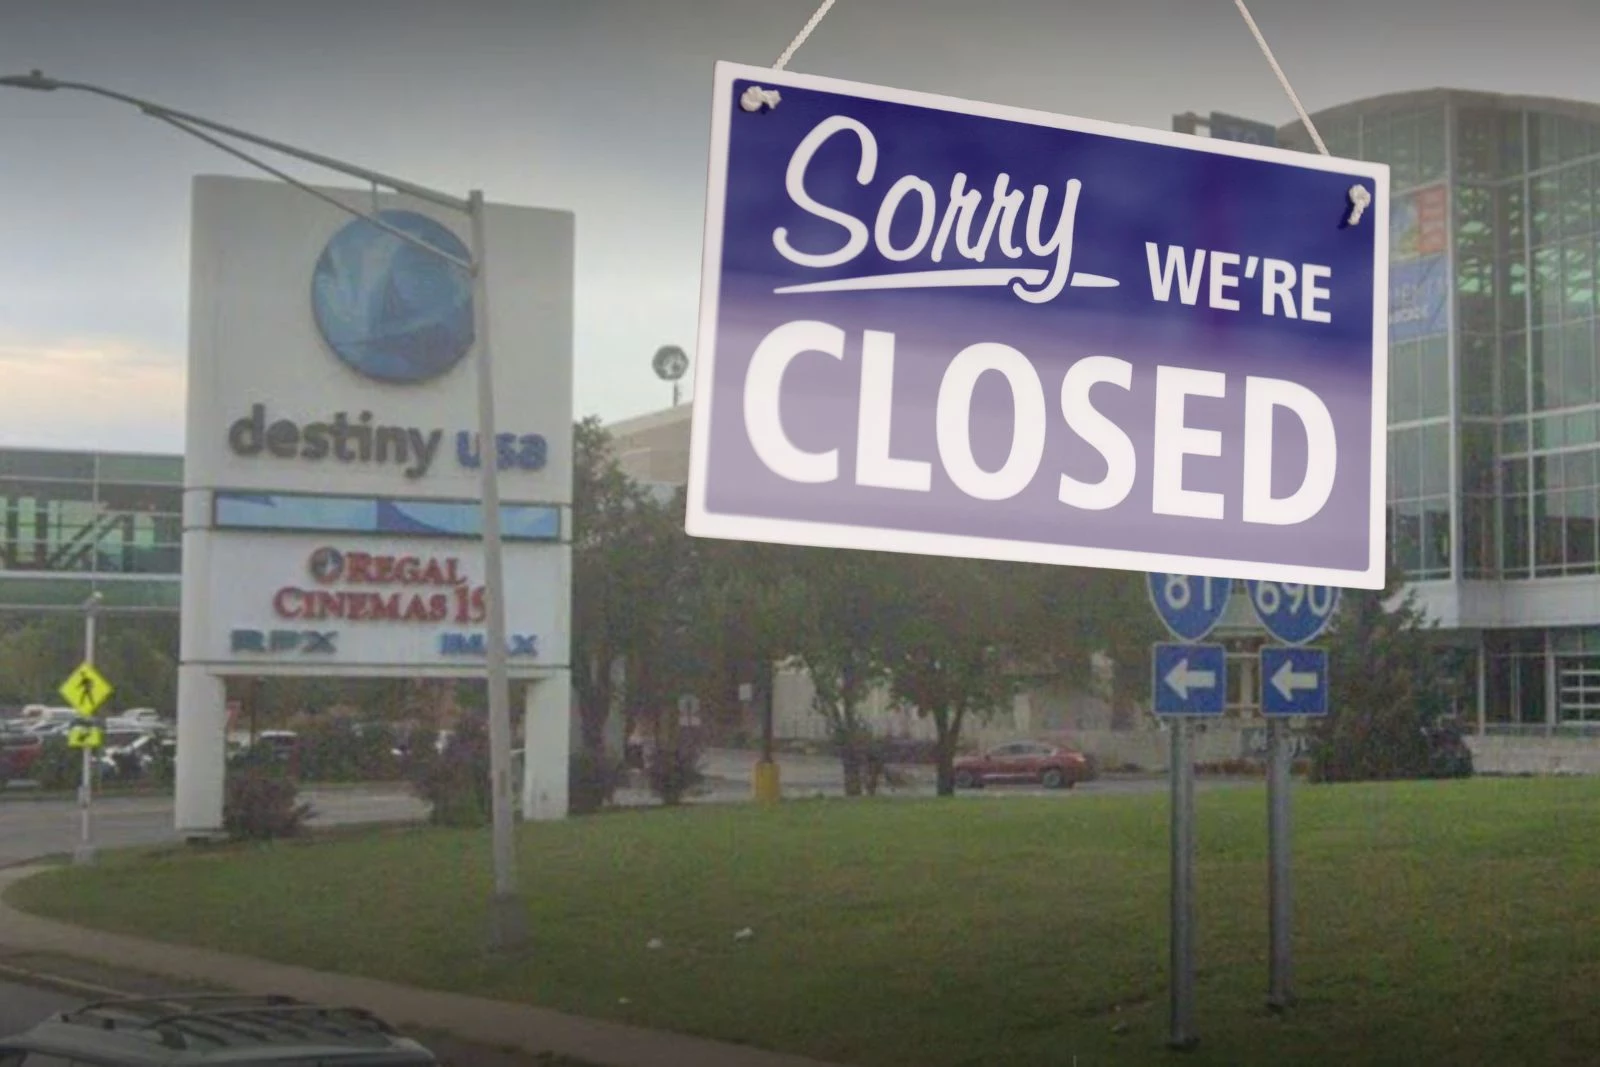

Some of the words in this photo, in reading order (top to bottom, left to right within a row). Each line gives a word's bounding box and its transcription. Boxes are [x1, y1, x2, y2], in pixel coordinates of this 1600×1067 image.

[772, 114, 1082, 304] Sorry
[1145, 241, 1332, 324] WE'RE
[228, 404, 443, 480] destiny
[455, 430, 548, 471] usa
[743, 319, 1337, 525] CLOSED
[344, 552, 467, 586] REGAL
[273, 586, 447, 622] CINEMAS
[230, 630, 339, 655] RPX
[440, 632, 539, 657] IMX
